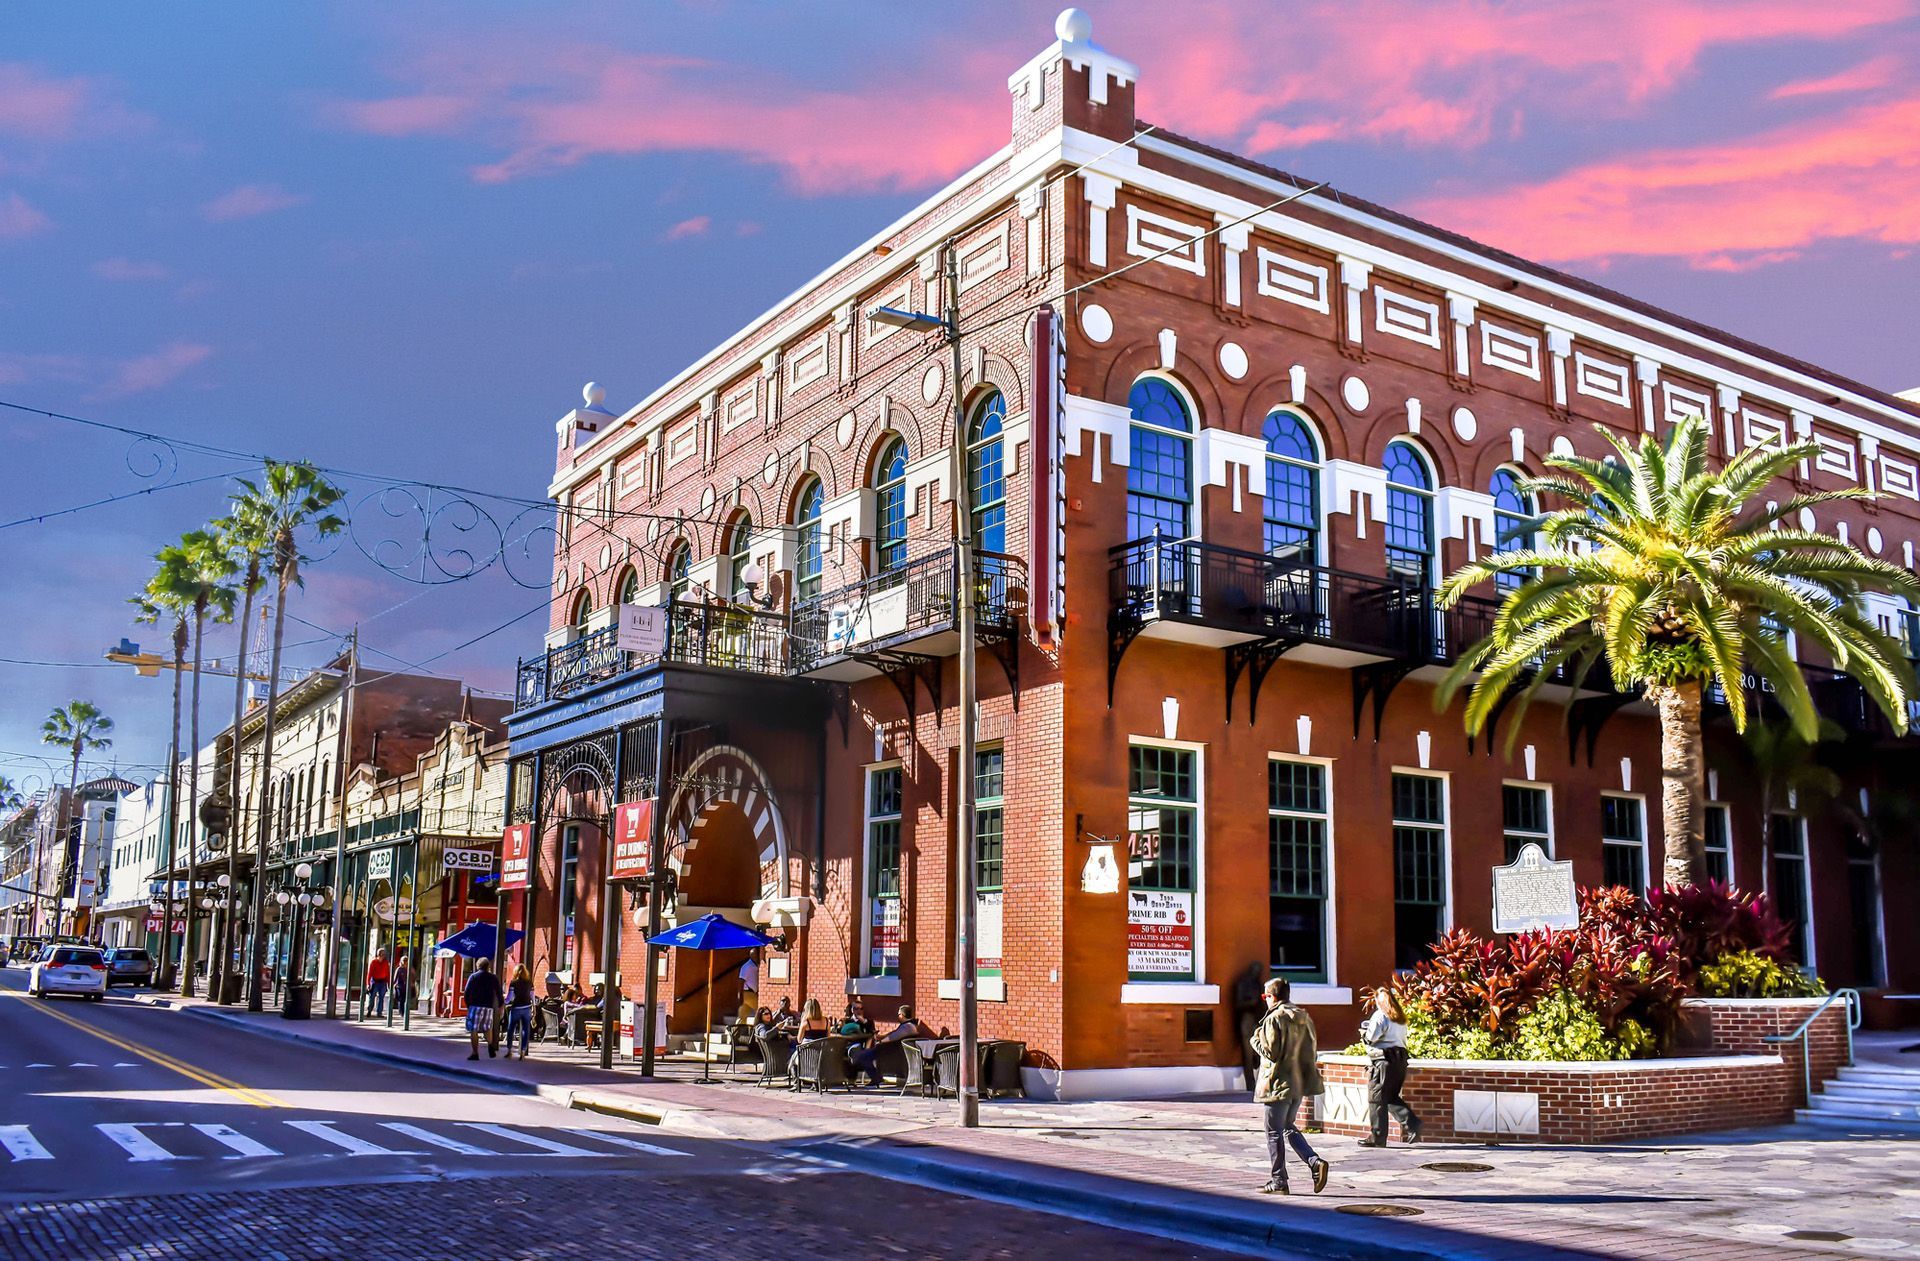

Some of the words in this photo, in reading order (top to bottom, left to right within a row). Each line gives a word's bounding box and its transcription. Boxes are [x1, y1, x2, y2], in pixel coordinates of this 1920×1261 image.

[552, 660, 581, 684] CENTRO
[458, 851, 492, 863] CBD
[1128, 910, 1152, 918] PRIME
[1141, 925, 1156, 933] 50%
[1158, 925, 1174, 934] OFF
